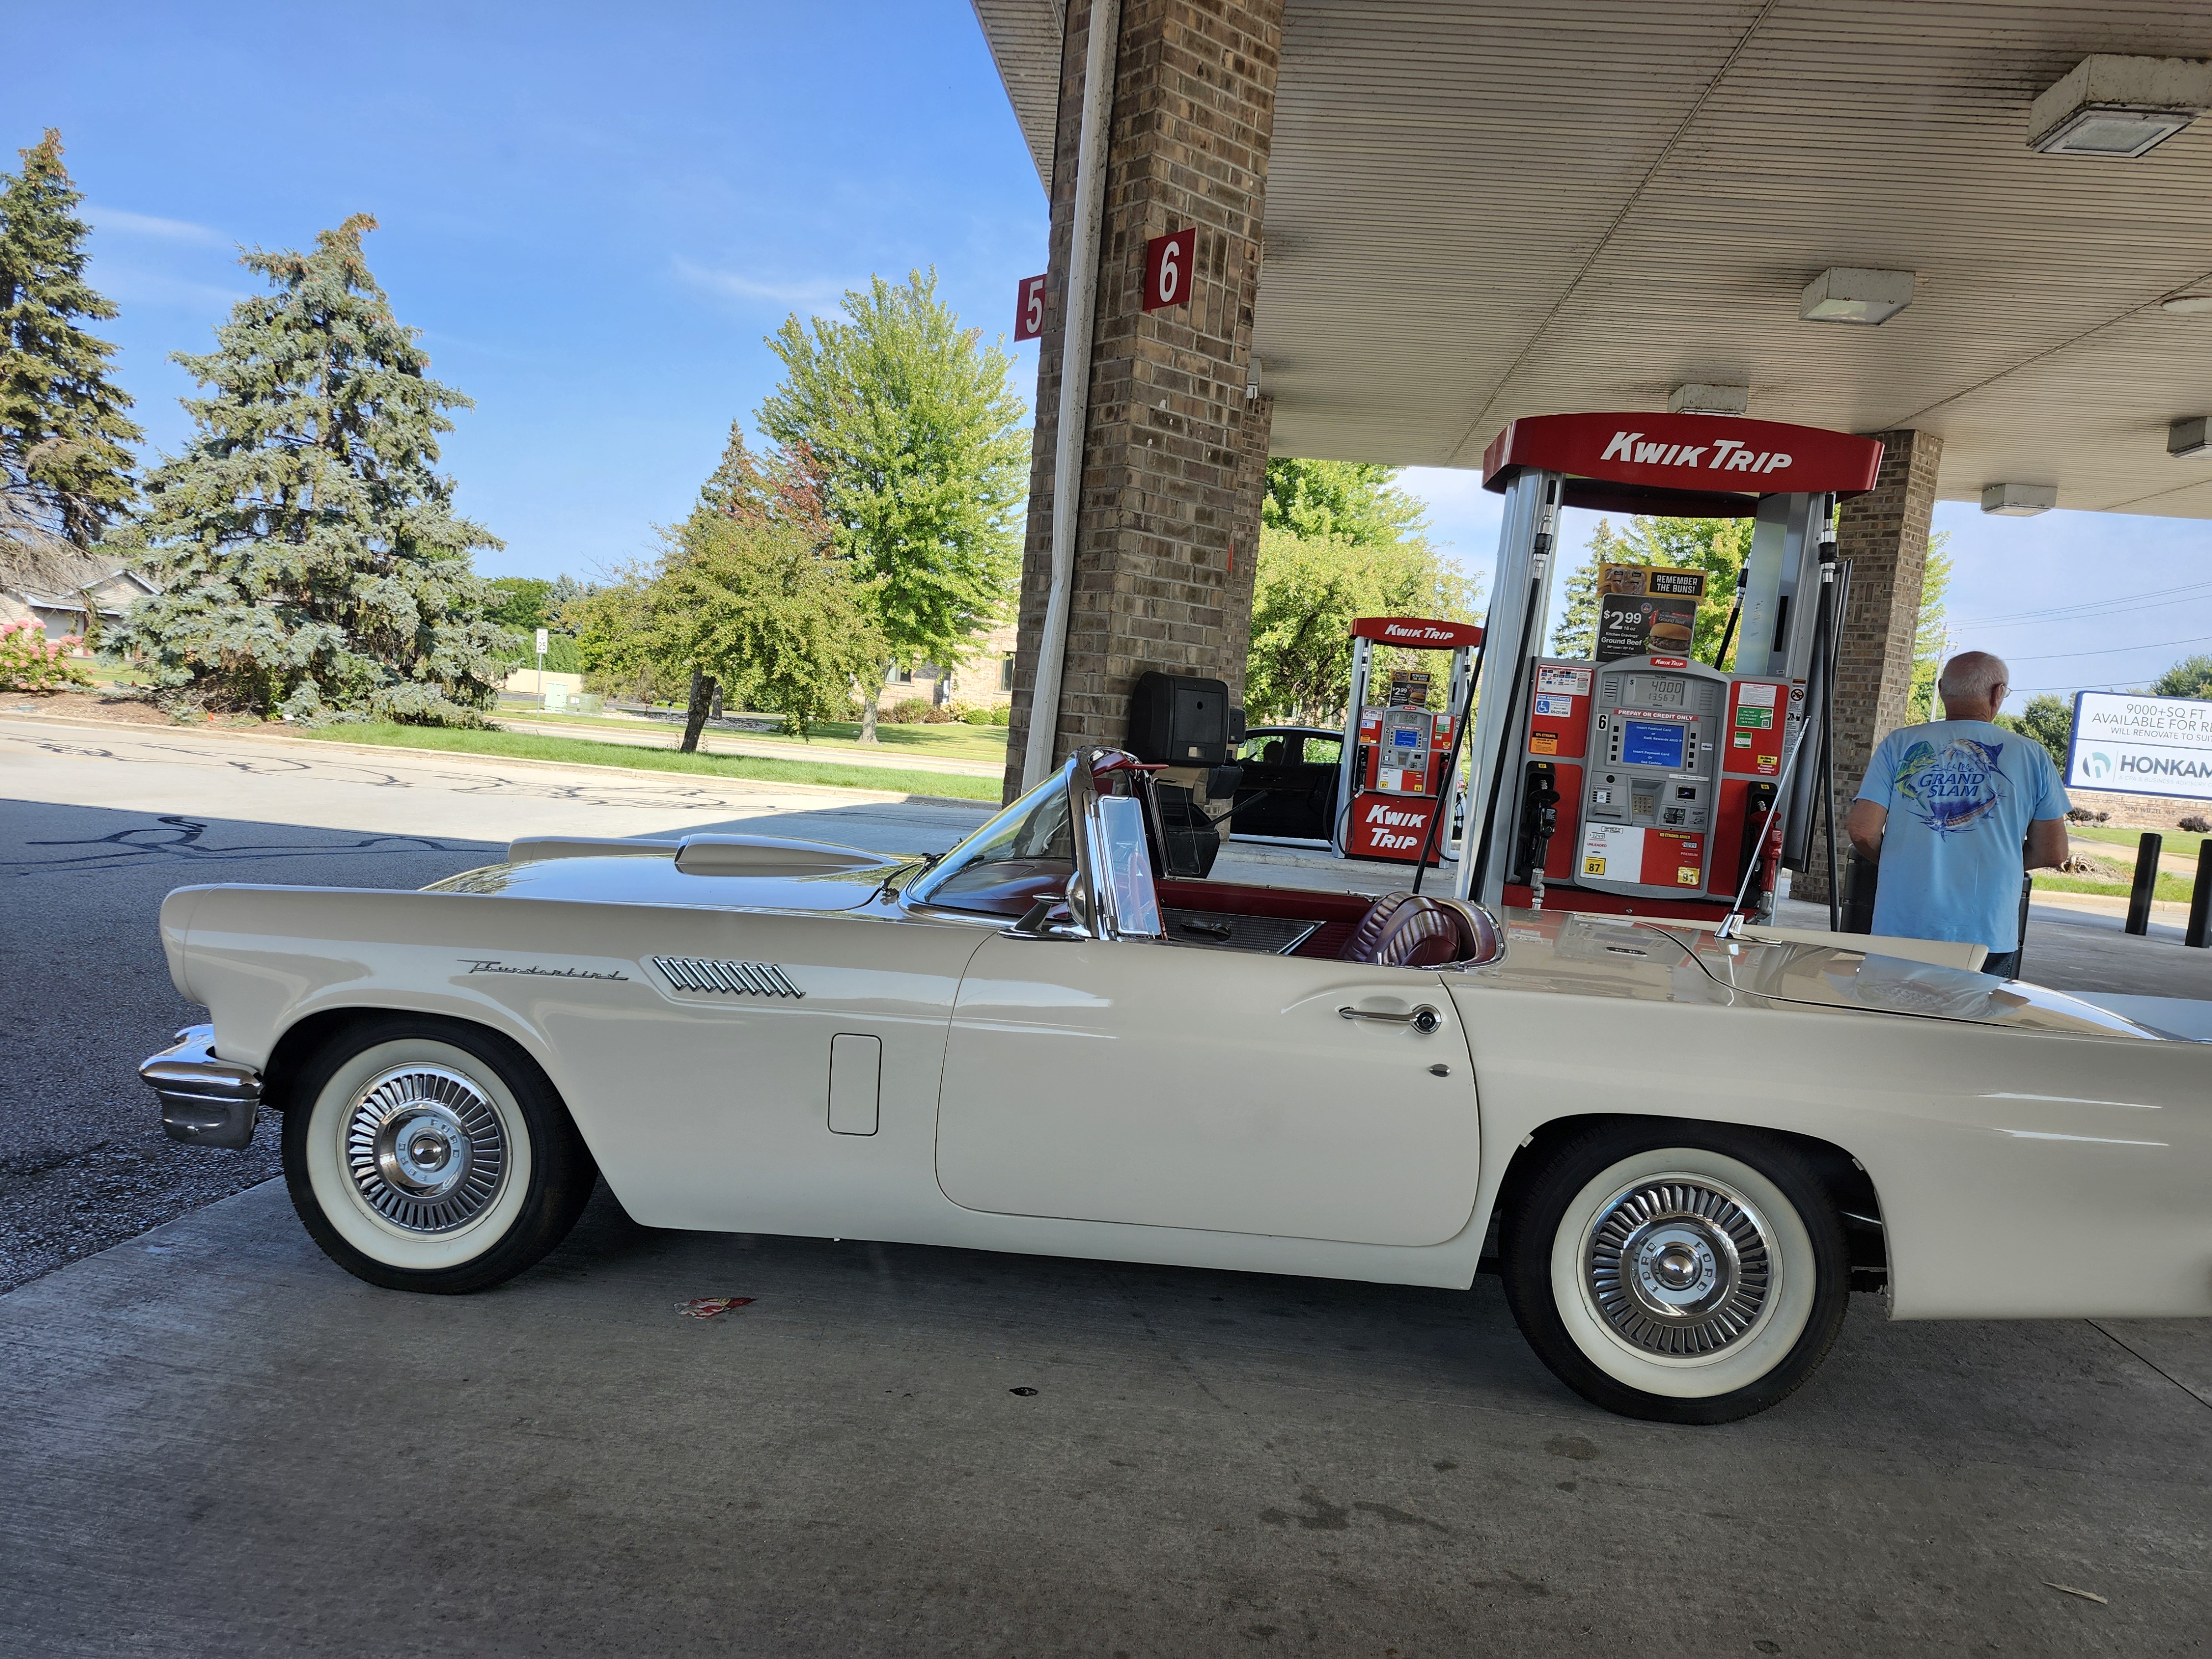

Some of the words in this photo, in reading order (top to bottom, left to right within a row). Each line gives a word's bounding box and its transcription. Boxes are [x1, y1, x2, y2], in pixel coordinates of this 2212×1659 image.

[1160, 241, 1180, 302] 6
[1026, 279, 1043, 333] 5
[1600, 431, 1709, 467] KWIK
[1709, 439, 1792, 473] TRIP
[1656, 575, 1698, 586] REMEMBER
[1656, 583, 1670, 592] THE
[1672, 585, 1695, 594] BUNS!
[1385, 624, 1424, 638] KWIK
[1423, 627, 1454, 640] TRIP
[538, 642, 546, 650] 25
[1601, 637, 1625, 645] Ground
[2126, 704, 2185, 718] 9000+SQ
[2190, 709, 2206, 720] FT
[1599, 715, 1606, 729] 6
[2092, 713, 2164, 728] AVAILABLE
[2169, 719, 2196, 731] FOR
[2133, 729, 2178, 739] RENOVATE
[1918, 774, 1985, 787] GRAND
[1927, 785, 1979, 798] SLAM
[1365, 805, 1427, 828] KWIK
[1370, 827, 1417, 849] TRIP
[1589, 863, 1600, 872] 87
[1682, 873, 1694, 883] 91
[456, 959, 629, 980] Thunderbird
[430, 1118, 460, 1159] FORD
[398, 1142, 428, 1182] FORD
[1640, 1241, 1658, 1293] FORD
[1693, 1240, 1715, 1292] FORD
